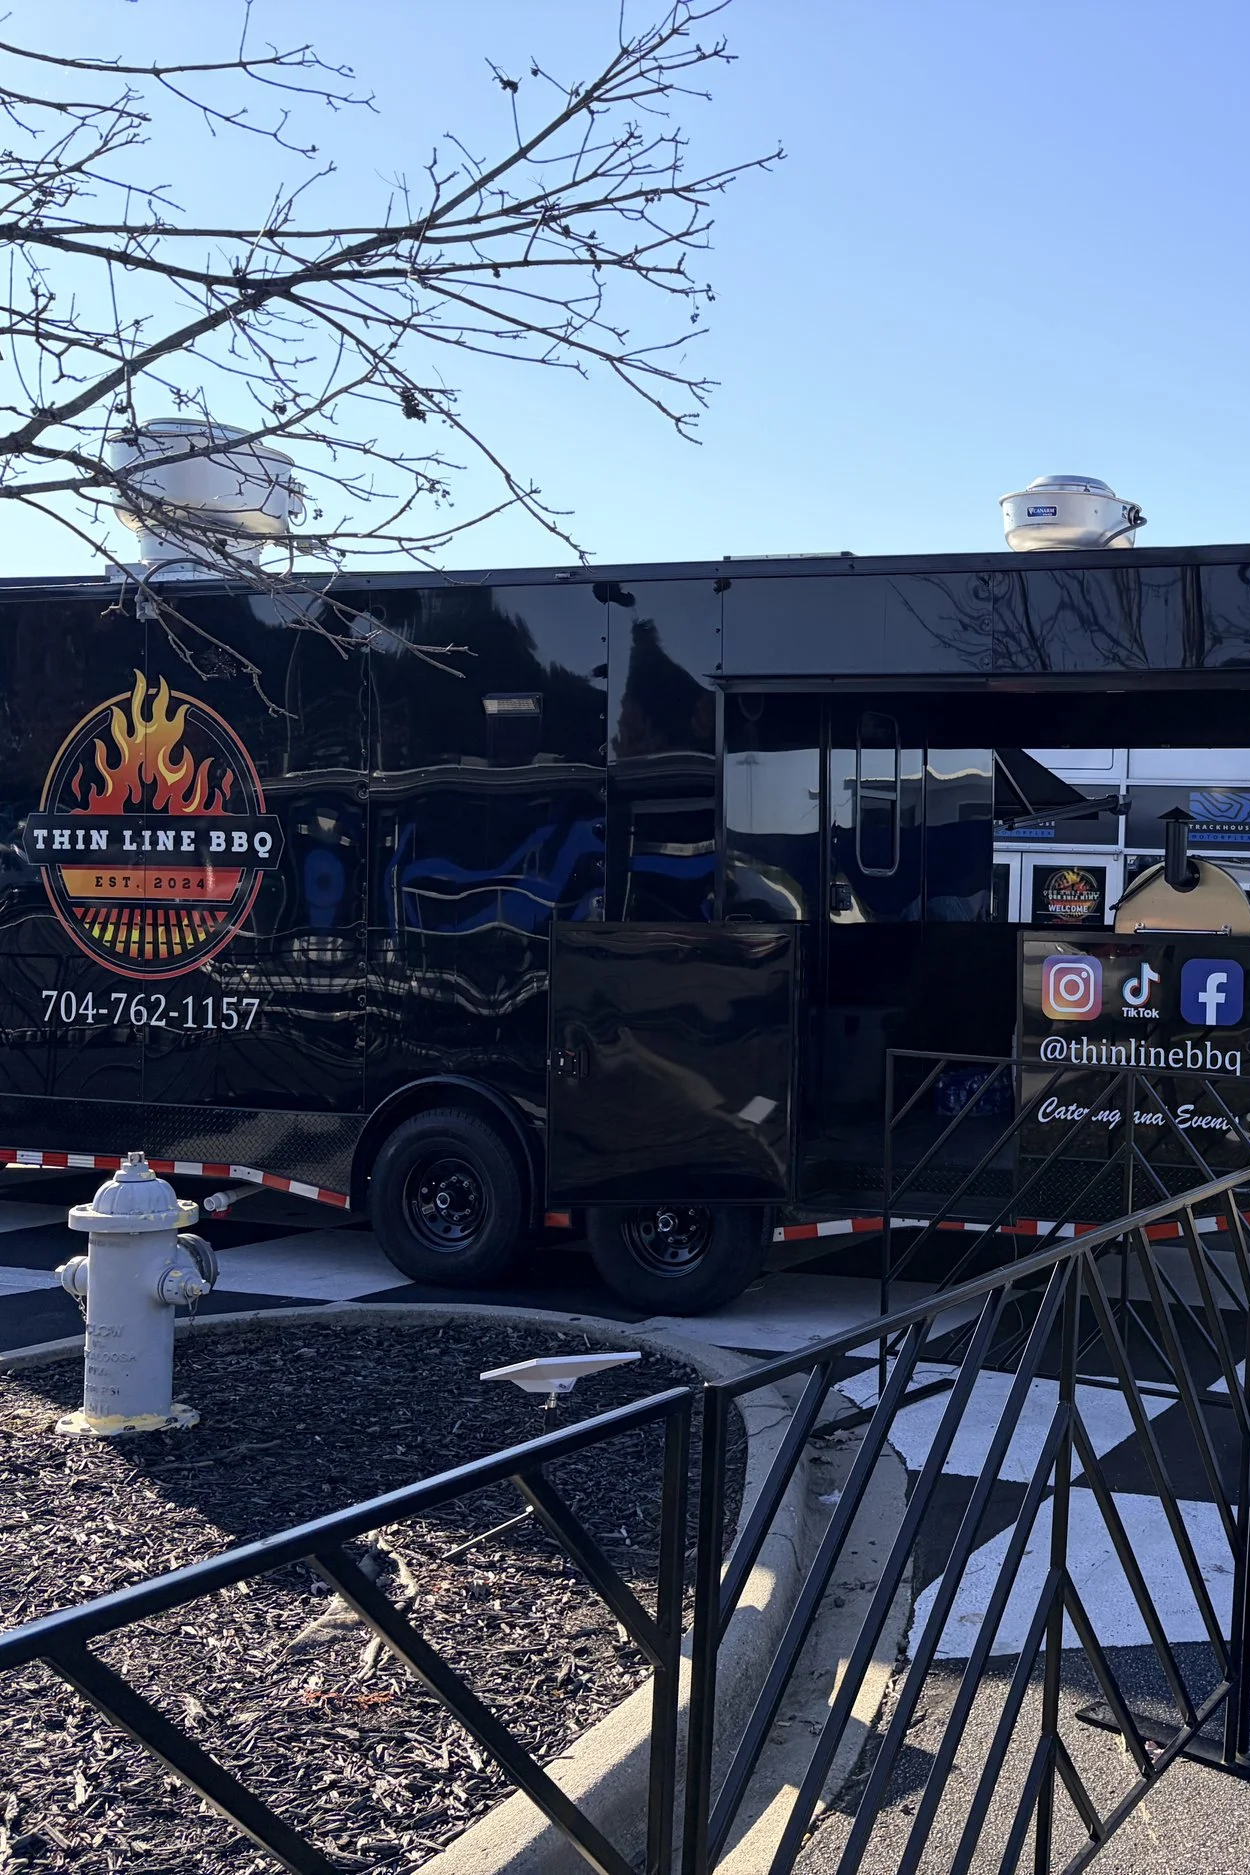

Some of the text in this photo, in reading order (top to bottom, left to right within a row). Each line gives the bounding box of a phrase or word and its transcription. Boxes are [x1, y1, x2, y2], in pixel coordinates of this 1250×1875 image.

[33, 829, 273, 858] THIN LINE BBQ
[95, 876, 206, 891] EST. 2024
[41, 989, 260, 1031] 704-762-1157
[1122, 1007, 1160, 1019] TikTok
[1040, 1035, 1242, 1076] @thinlinebbq
